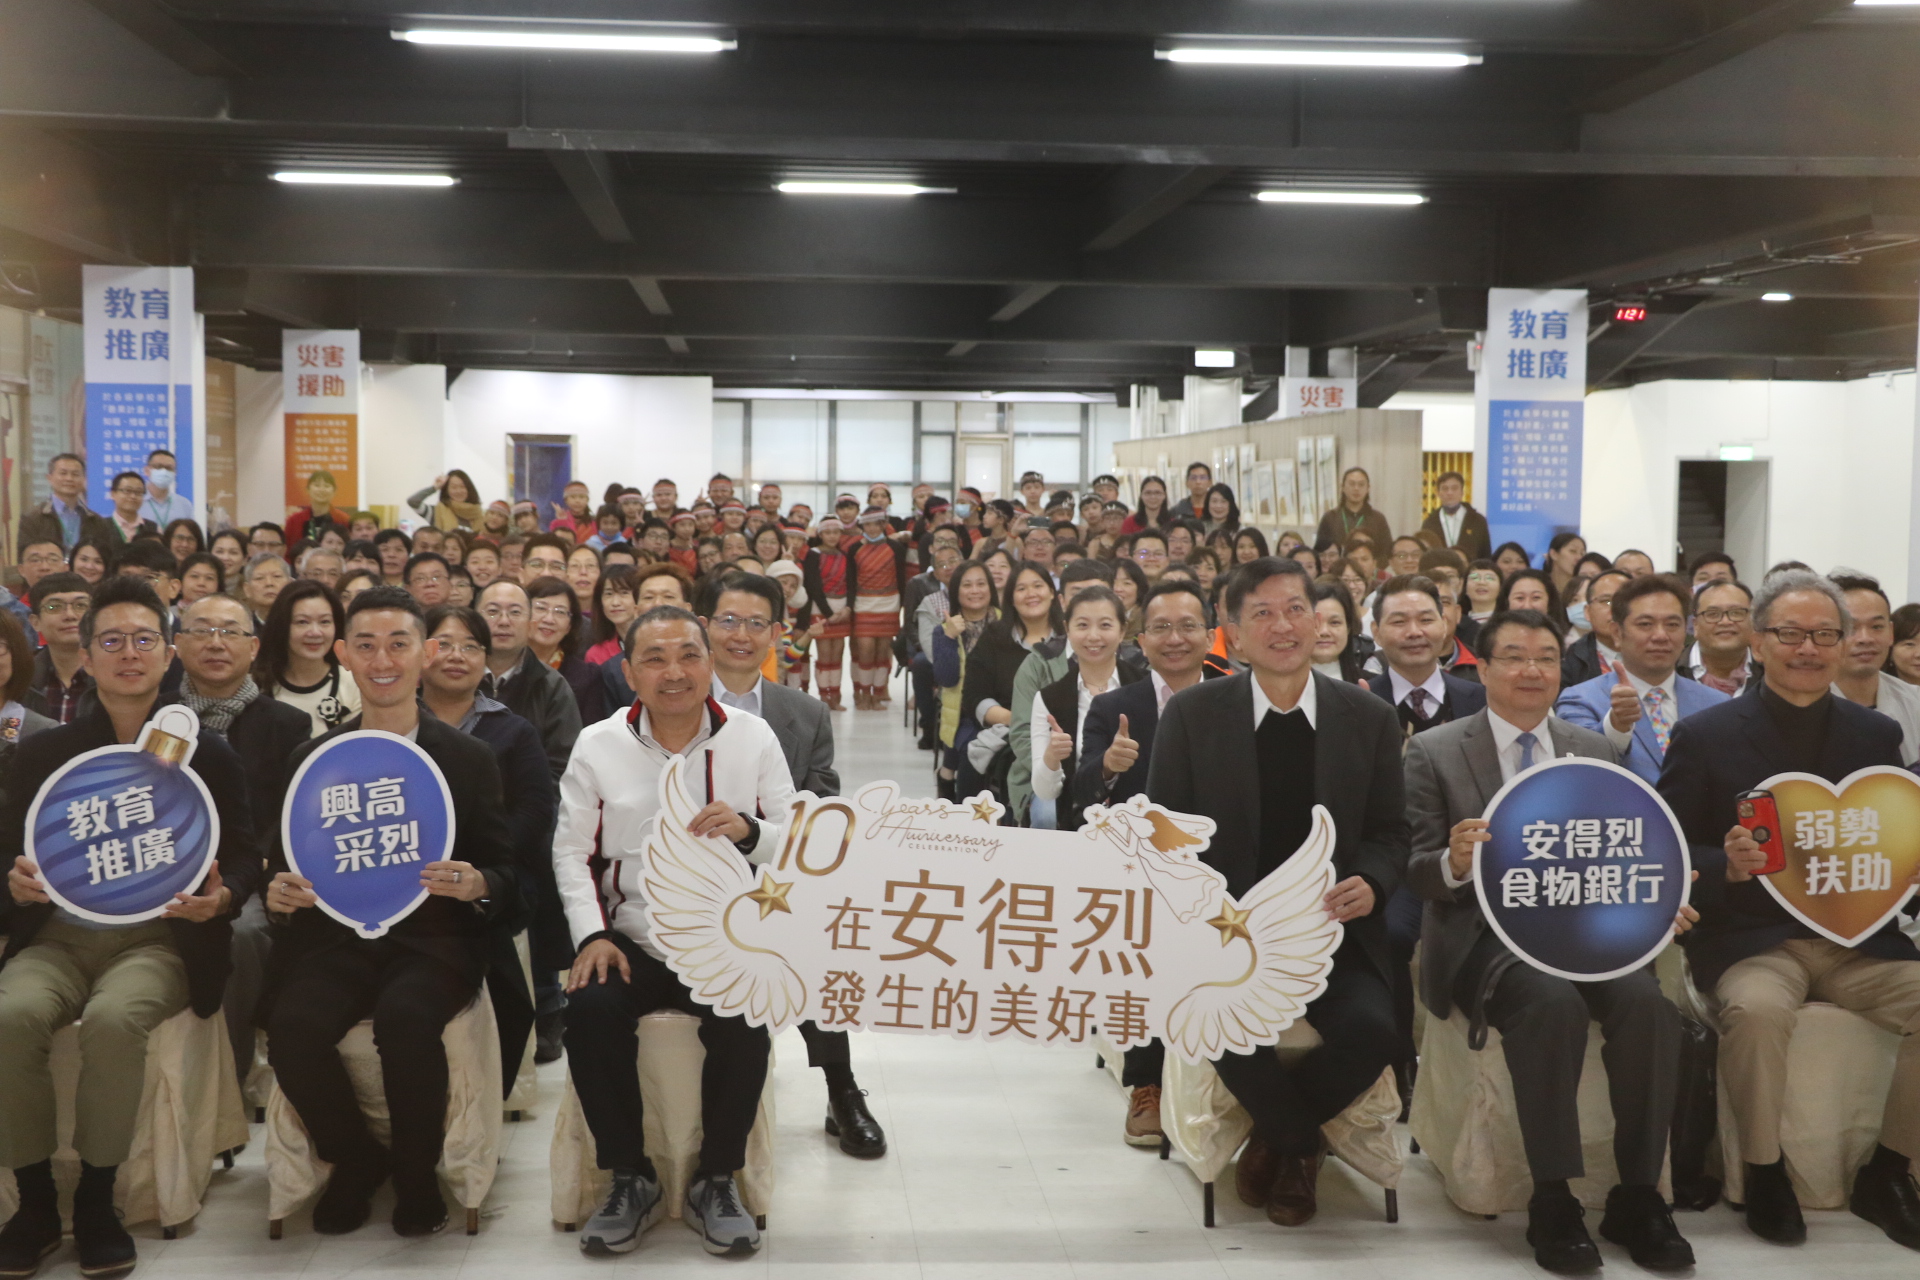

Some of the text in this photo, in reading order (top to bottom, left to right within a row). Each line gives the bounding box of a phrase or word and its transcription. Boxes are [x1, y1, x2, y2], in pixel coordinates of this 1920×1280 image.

[104, 286, 170, 320] 教育
[1508, 308, 1570, 340] 教育
[104, 328, 170, 361] 推廣
[297, 344, 345, 368] 災害
[1507, 348, 1569, 379] 推廣
[297, 373, 346, 397] 援助
[1300, 385, 1344, 408] 災害
[67, 785, 156, 842] 教育
[320, 777, 406, 828] 興高
[858, 786, 970, 840] Years
[334, 820, 421, 874] 采烈
[777, 800, 856, 877] 10
[887, 815, 1004, 862] Anniversary
[908, 842, 980, 854] CELEBRATION
[1521, 817, 1644, 861] 安得烈
[1793, 807, 1881, 851] 弱勢
[85, 827, 178, 886] 推廣
[1805, 852, 1892, 896] 扶助
[1500, 863, 1665, 908] 食物銀行
[823, 868, 1154, 980] 在安得烈
[818, 969, 1151, 1046] 發生的美好事
